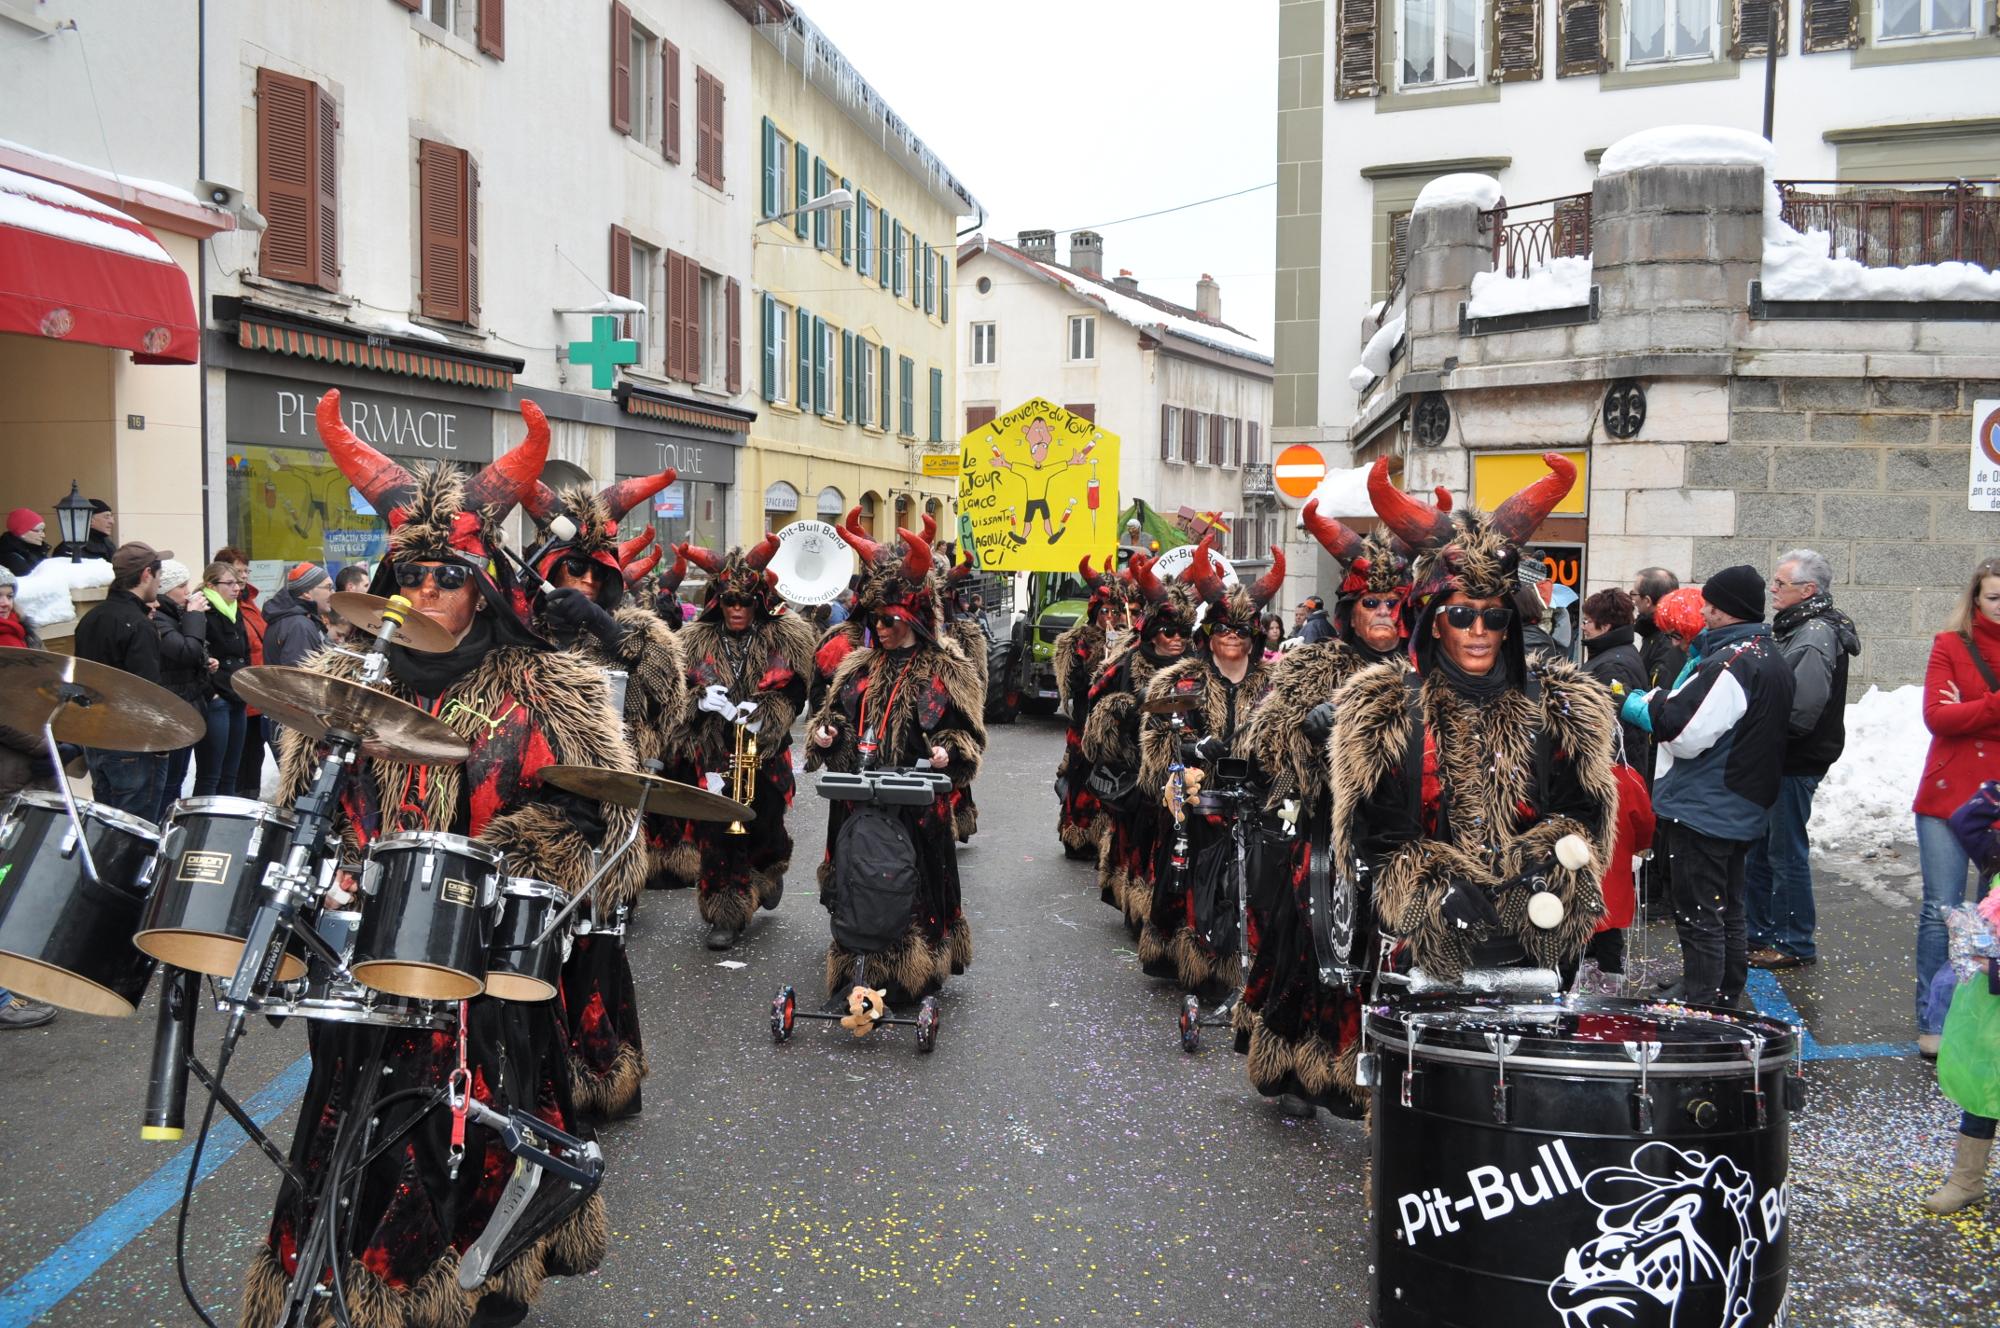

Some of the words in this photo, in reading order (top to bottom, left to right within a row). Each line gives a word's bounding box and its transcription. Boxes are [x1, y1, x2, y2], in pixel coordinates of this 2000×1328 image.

[132, 418, 142, 428] 16
[277, 391, 457, 450] PHRMACIE
[1048, 407, 1064, 422] du
[963, 448, 977, 468] Le
[1977, 470, 1987, 482] de
[959, 481, 973, 498] de
[1973, 487, 1983, 496] en
[779, 522, 820, 541] Pit-Bull
[822, 525, 847, 550] Band
[1159, 548, 1196, 569] Pit-Bu
[262, 941, 283, 982] YAMAHA
[1397, 1138, 1583, 1247] Pit-Bull
